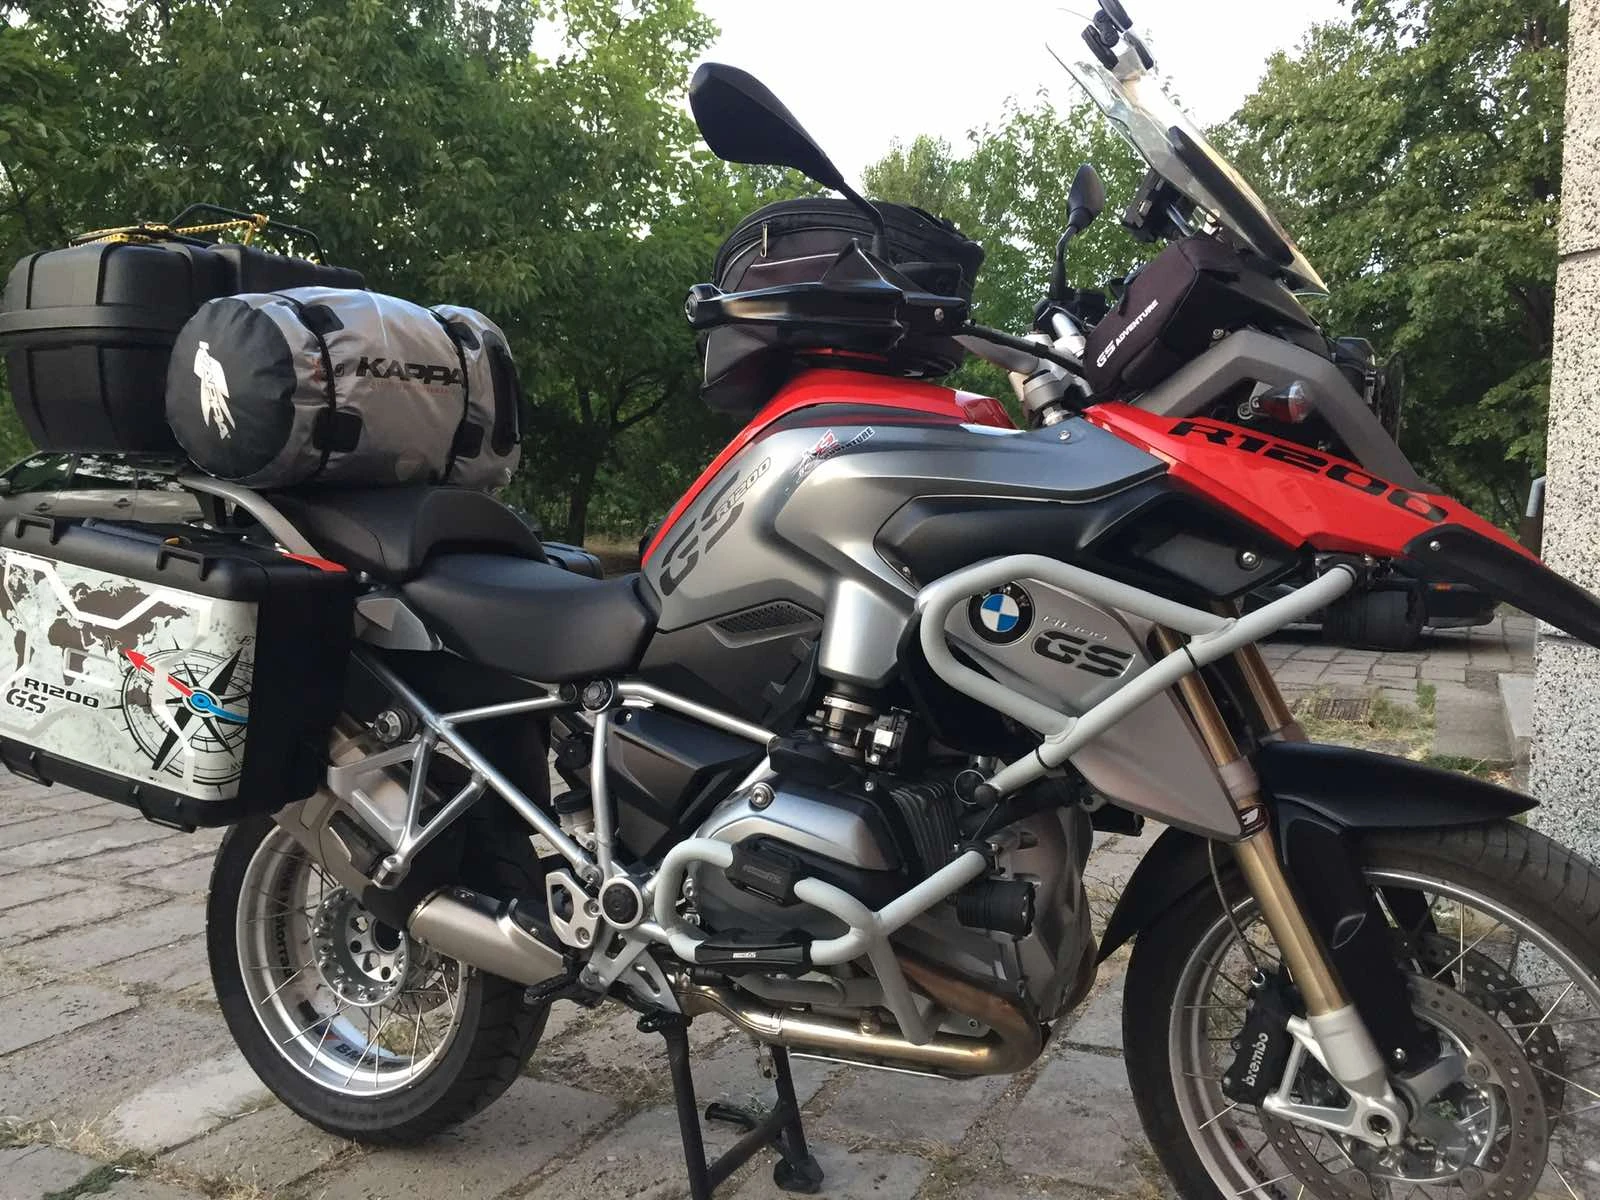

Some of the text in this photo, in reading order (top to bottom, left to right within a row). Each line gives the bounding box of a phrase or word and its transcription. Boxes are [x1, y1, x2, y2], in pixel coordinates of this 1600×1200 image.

[1096, 299, 1159, 368] GS ADVENTURE
[356, 356, 465, 386] KAPPA
[716, 456, 772, 521] R1200
[1168, 421, 1449, 523] R1200
[659, 470, 745, 597] GS
[1033, 630, 1136, 679] GS
[6, 688, 48, 714] GS
[24, 677, 99, 708] R1200
[1241, 1032, 1268, 1087] brembo
